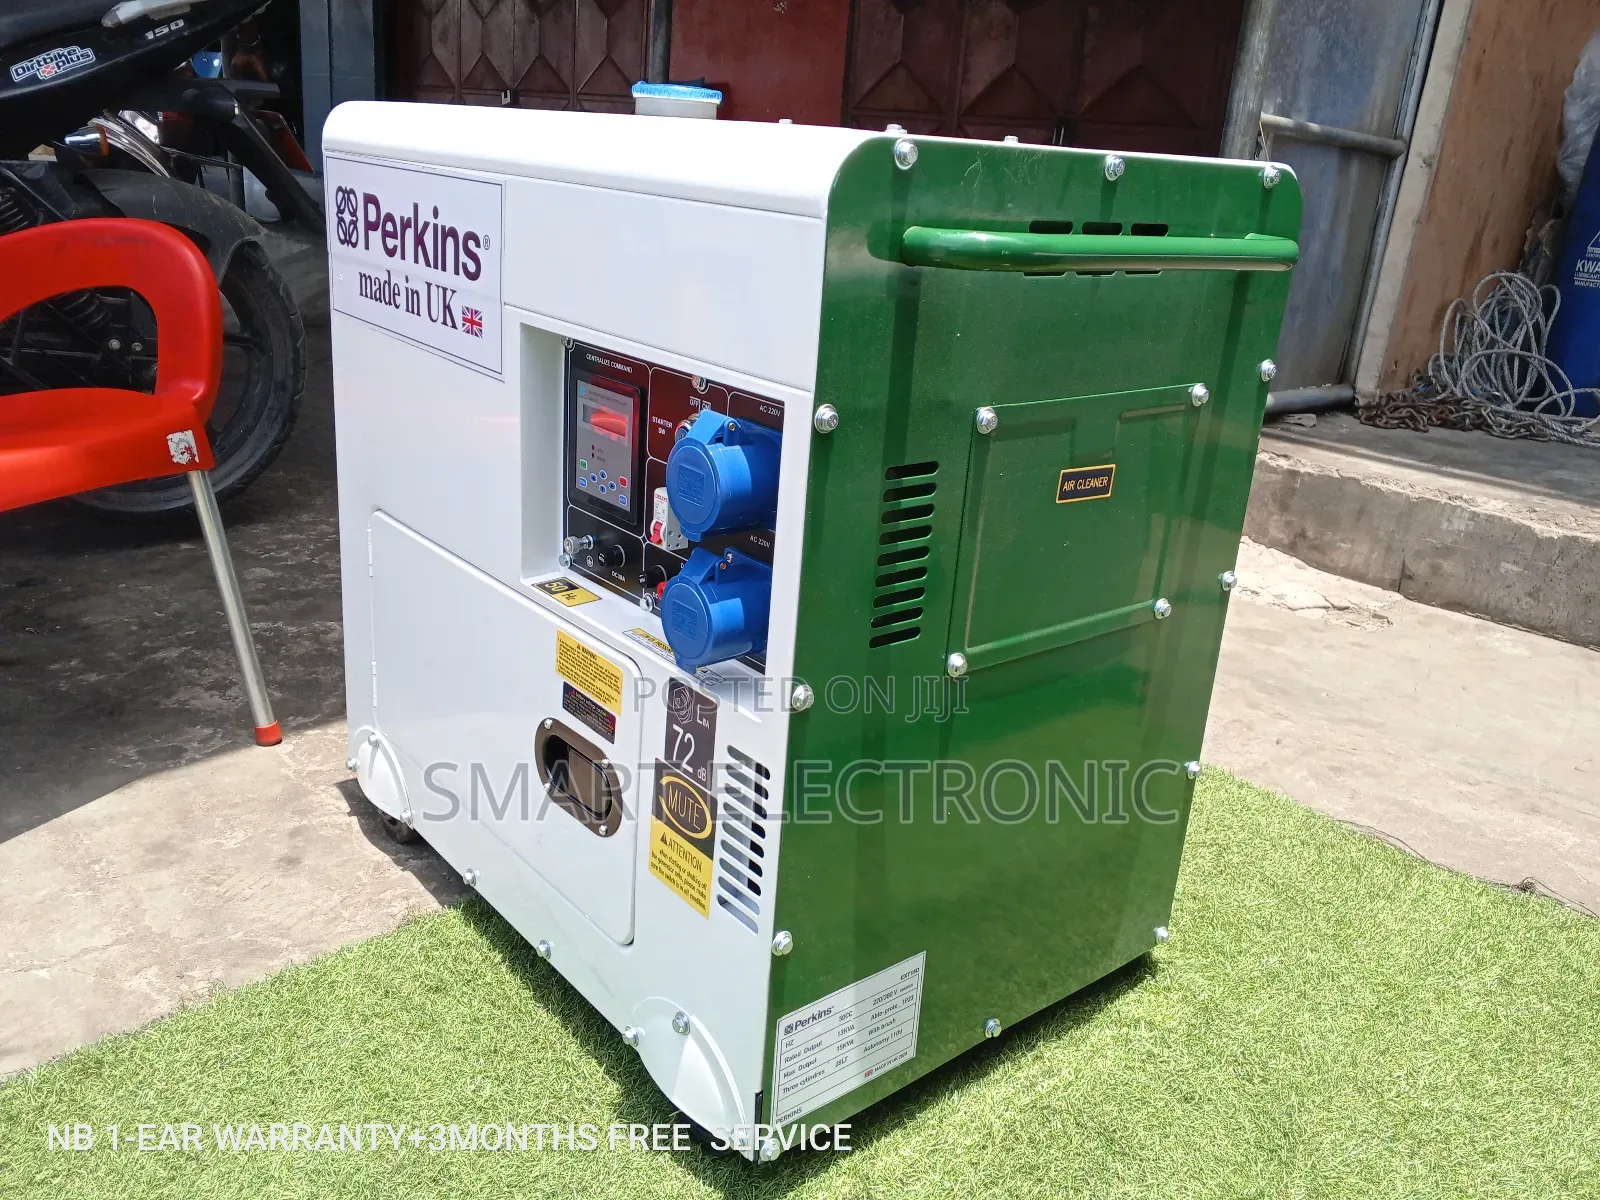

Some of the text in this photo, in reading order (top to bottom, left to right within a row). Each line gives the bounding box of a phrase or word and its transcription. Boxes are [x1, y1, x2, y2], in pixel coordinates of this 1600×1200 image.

[144, 18, 185, 40] 150
[13, 47, 79, 77] Dirtbike
[56, 51, 91, 72] plus
[358, 269, 459, 330] made in UK
[610, 361, 633, 374] COMMAND
[689, 398, 699, 408] OFF
[759, 404, 781, 417] AC 220V
[652, 416, 673, 429] STARTER
[1062, 476, 1109, 492] AIR CLEANER
[749, 534, 771, 549] AC 220V
[544, 581, 569, 593] 50
[672, 724, 707, 782] 72 dB
[667, 784, 703, 831] MUTE
[667, 838, 702, 873] ATTENTION
[803, 1040, 823, 1054] Output
[783, 1057, 817, 1079] Max Output
[782, 1083, 799, 1094] Three
[775, 1107, 803, 1125] PERKINS
